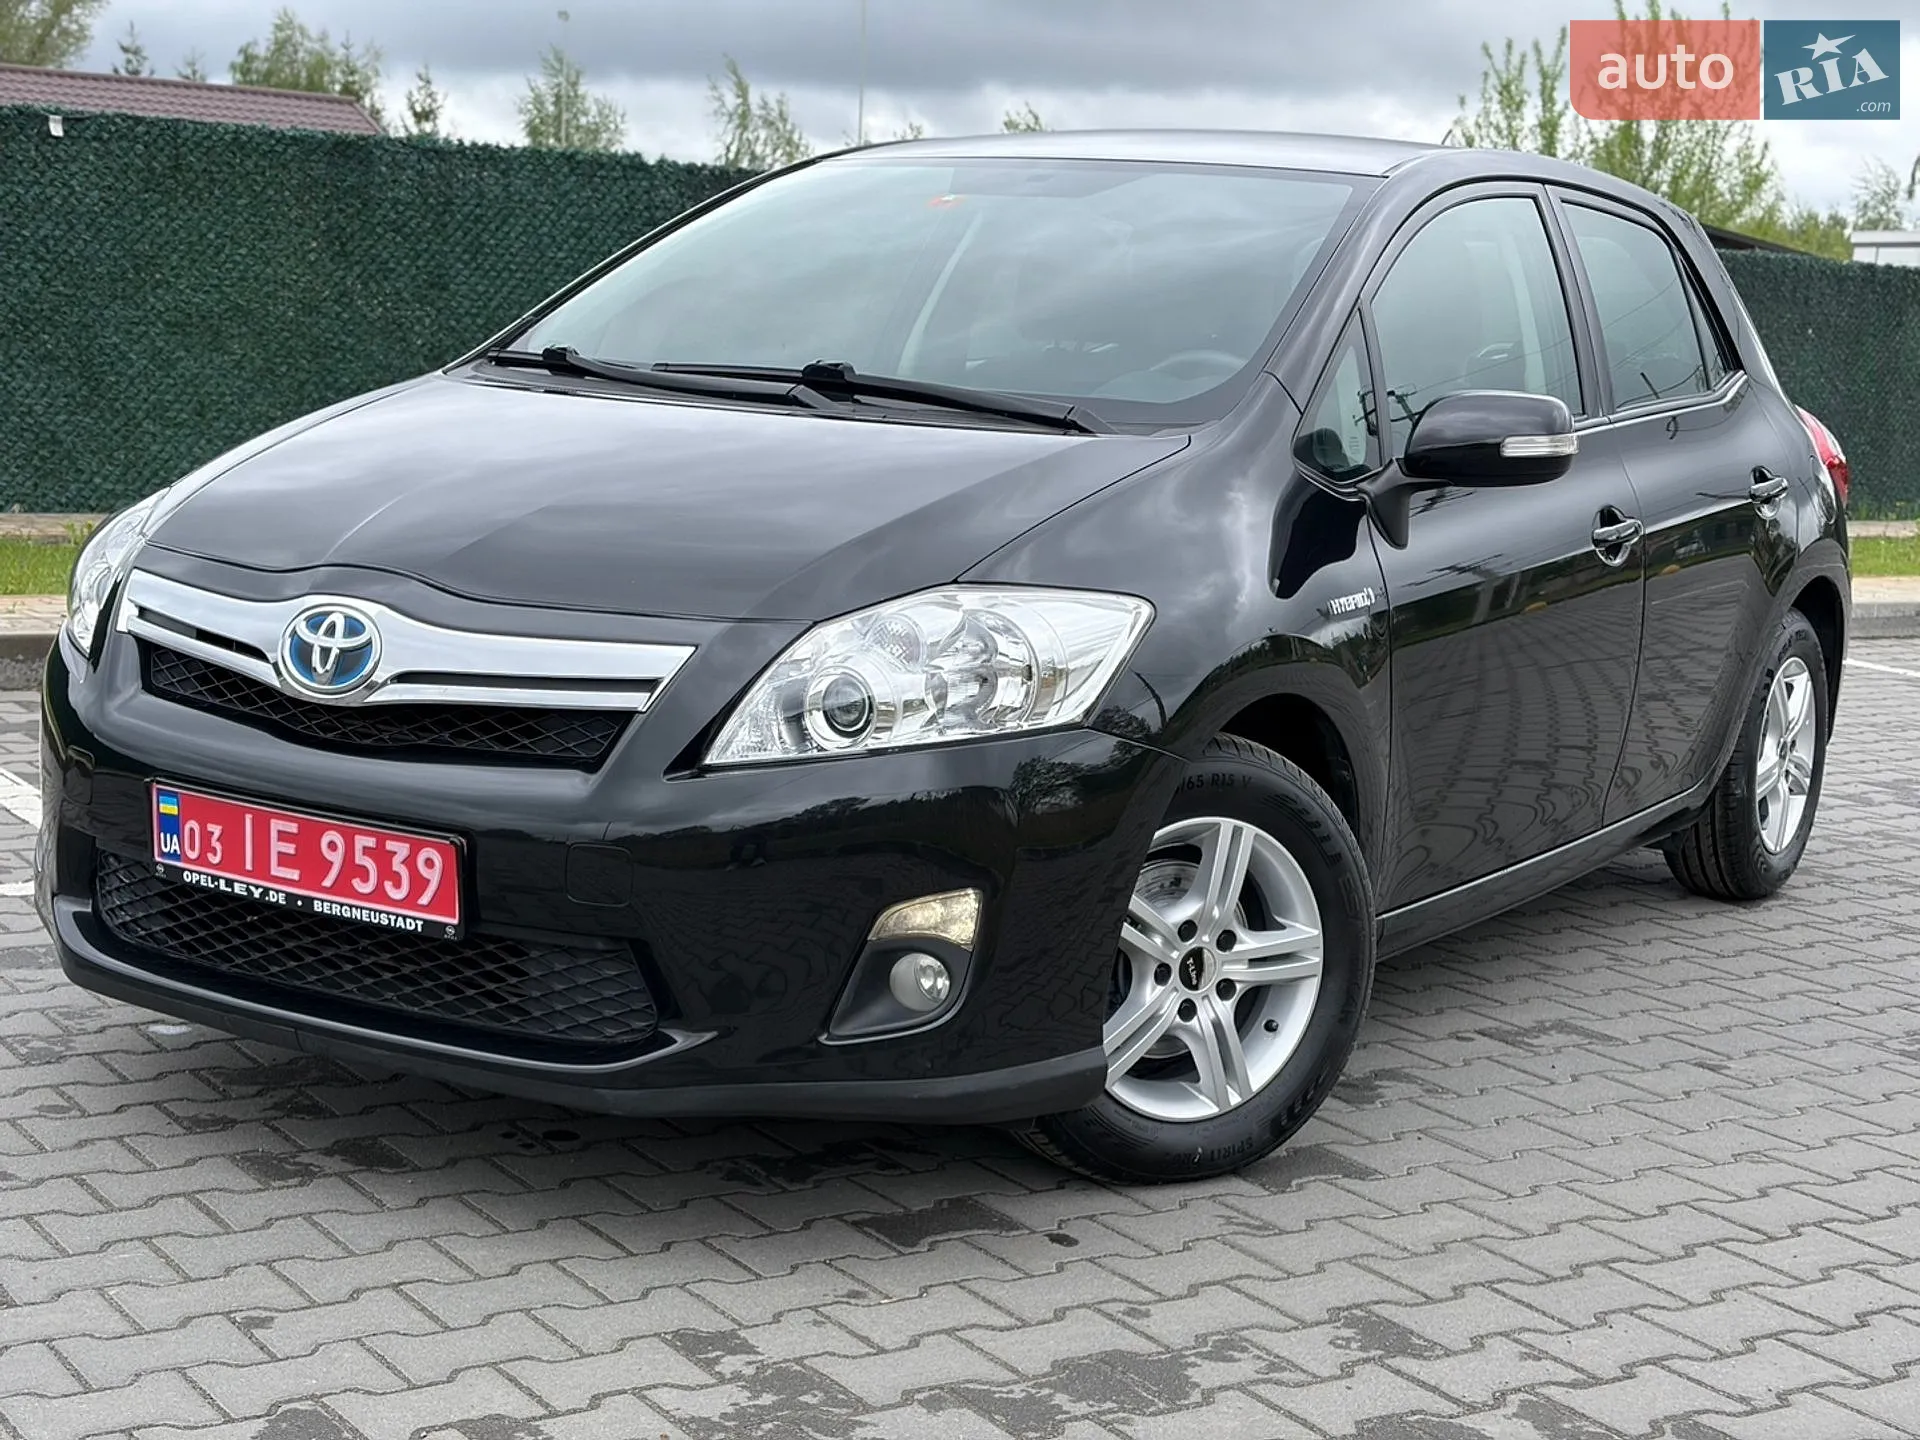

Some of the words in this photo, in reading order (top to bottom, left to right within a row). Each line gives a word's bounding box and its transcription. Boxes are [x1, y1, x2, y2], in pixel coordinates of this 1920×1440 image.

[160, 832, 180, 855] UA
[183, 819, 223, 865] 03
[245, 813, 300, 882] IE
[320, 830, 443, 906] 9539
[313, 900, 424, 933] BERGNEUSTADT
